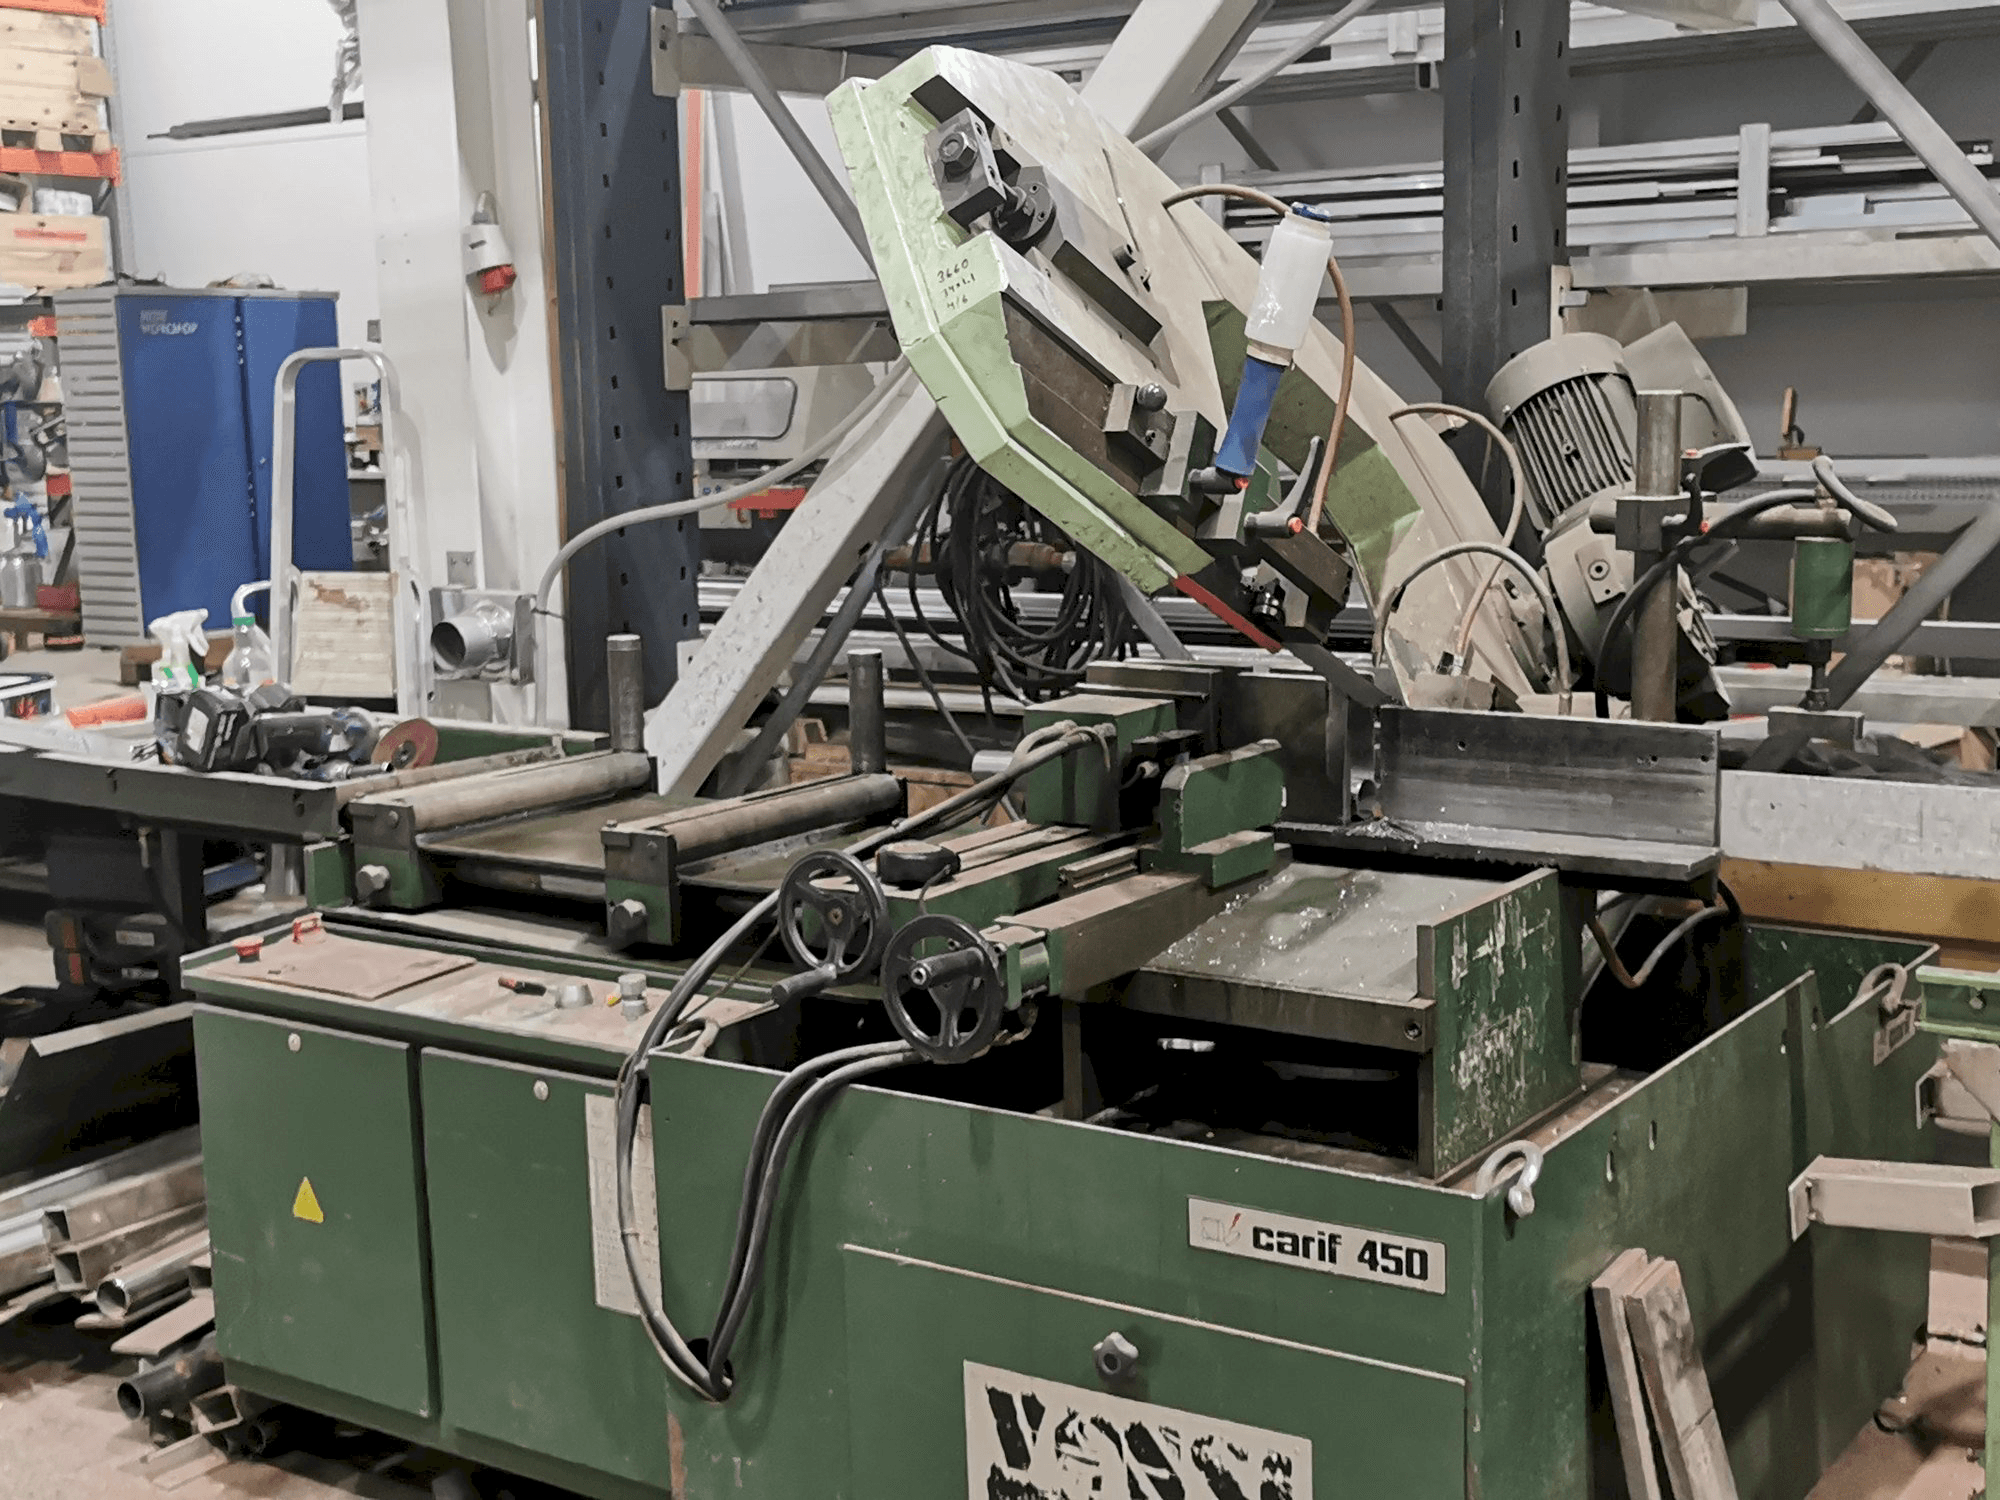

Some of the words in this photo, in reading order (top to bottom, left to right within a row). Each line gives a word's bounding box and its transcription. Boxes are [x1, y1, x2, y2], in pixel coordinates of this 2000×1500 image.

[937, 258, 969, 283] 3660
[1252, 1226, 1342, 1265] carif
[1357, 1239, 1429, 1281] 450
